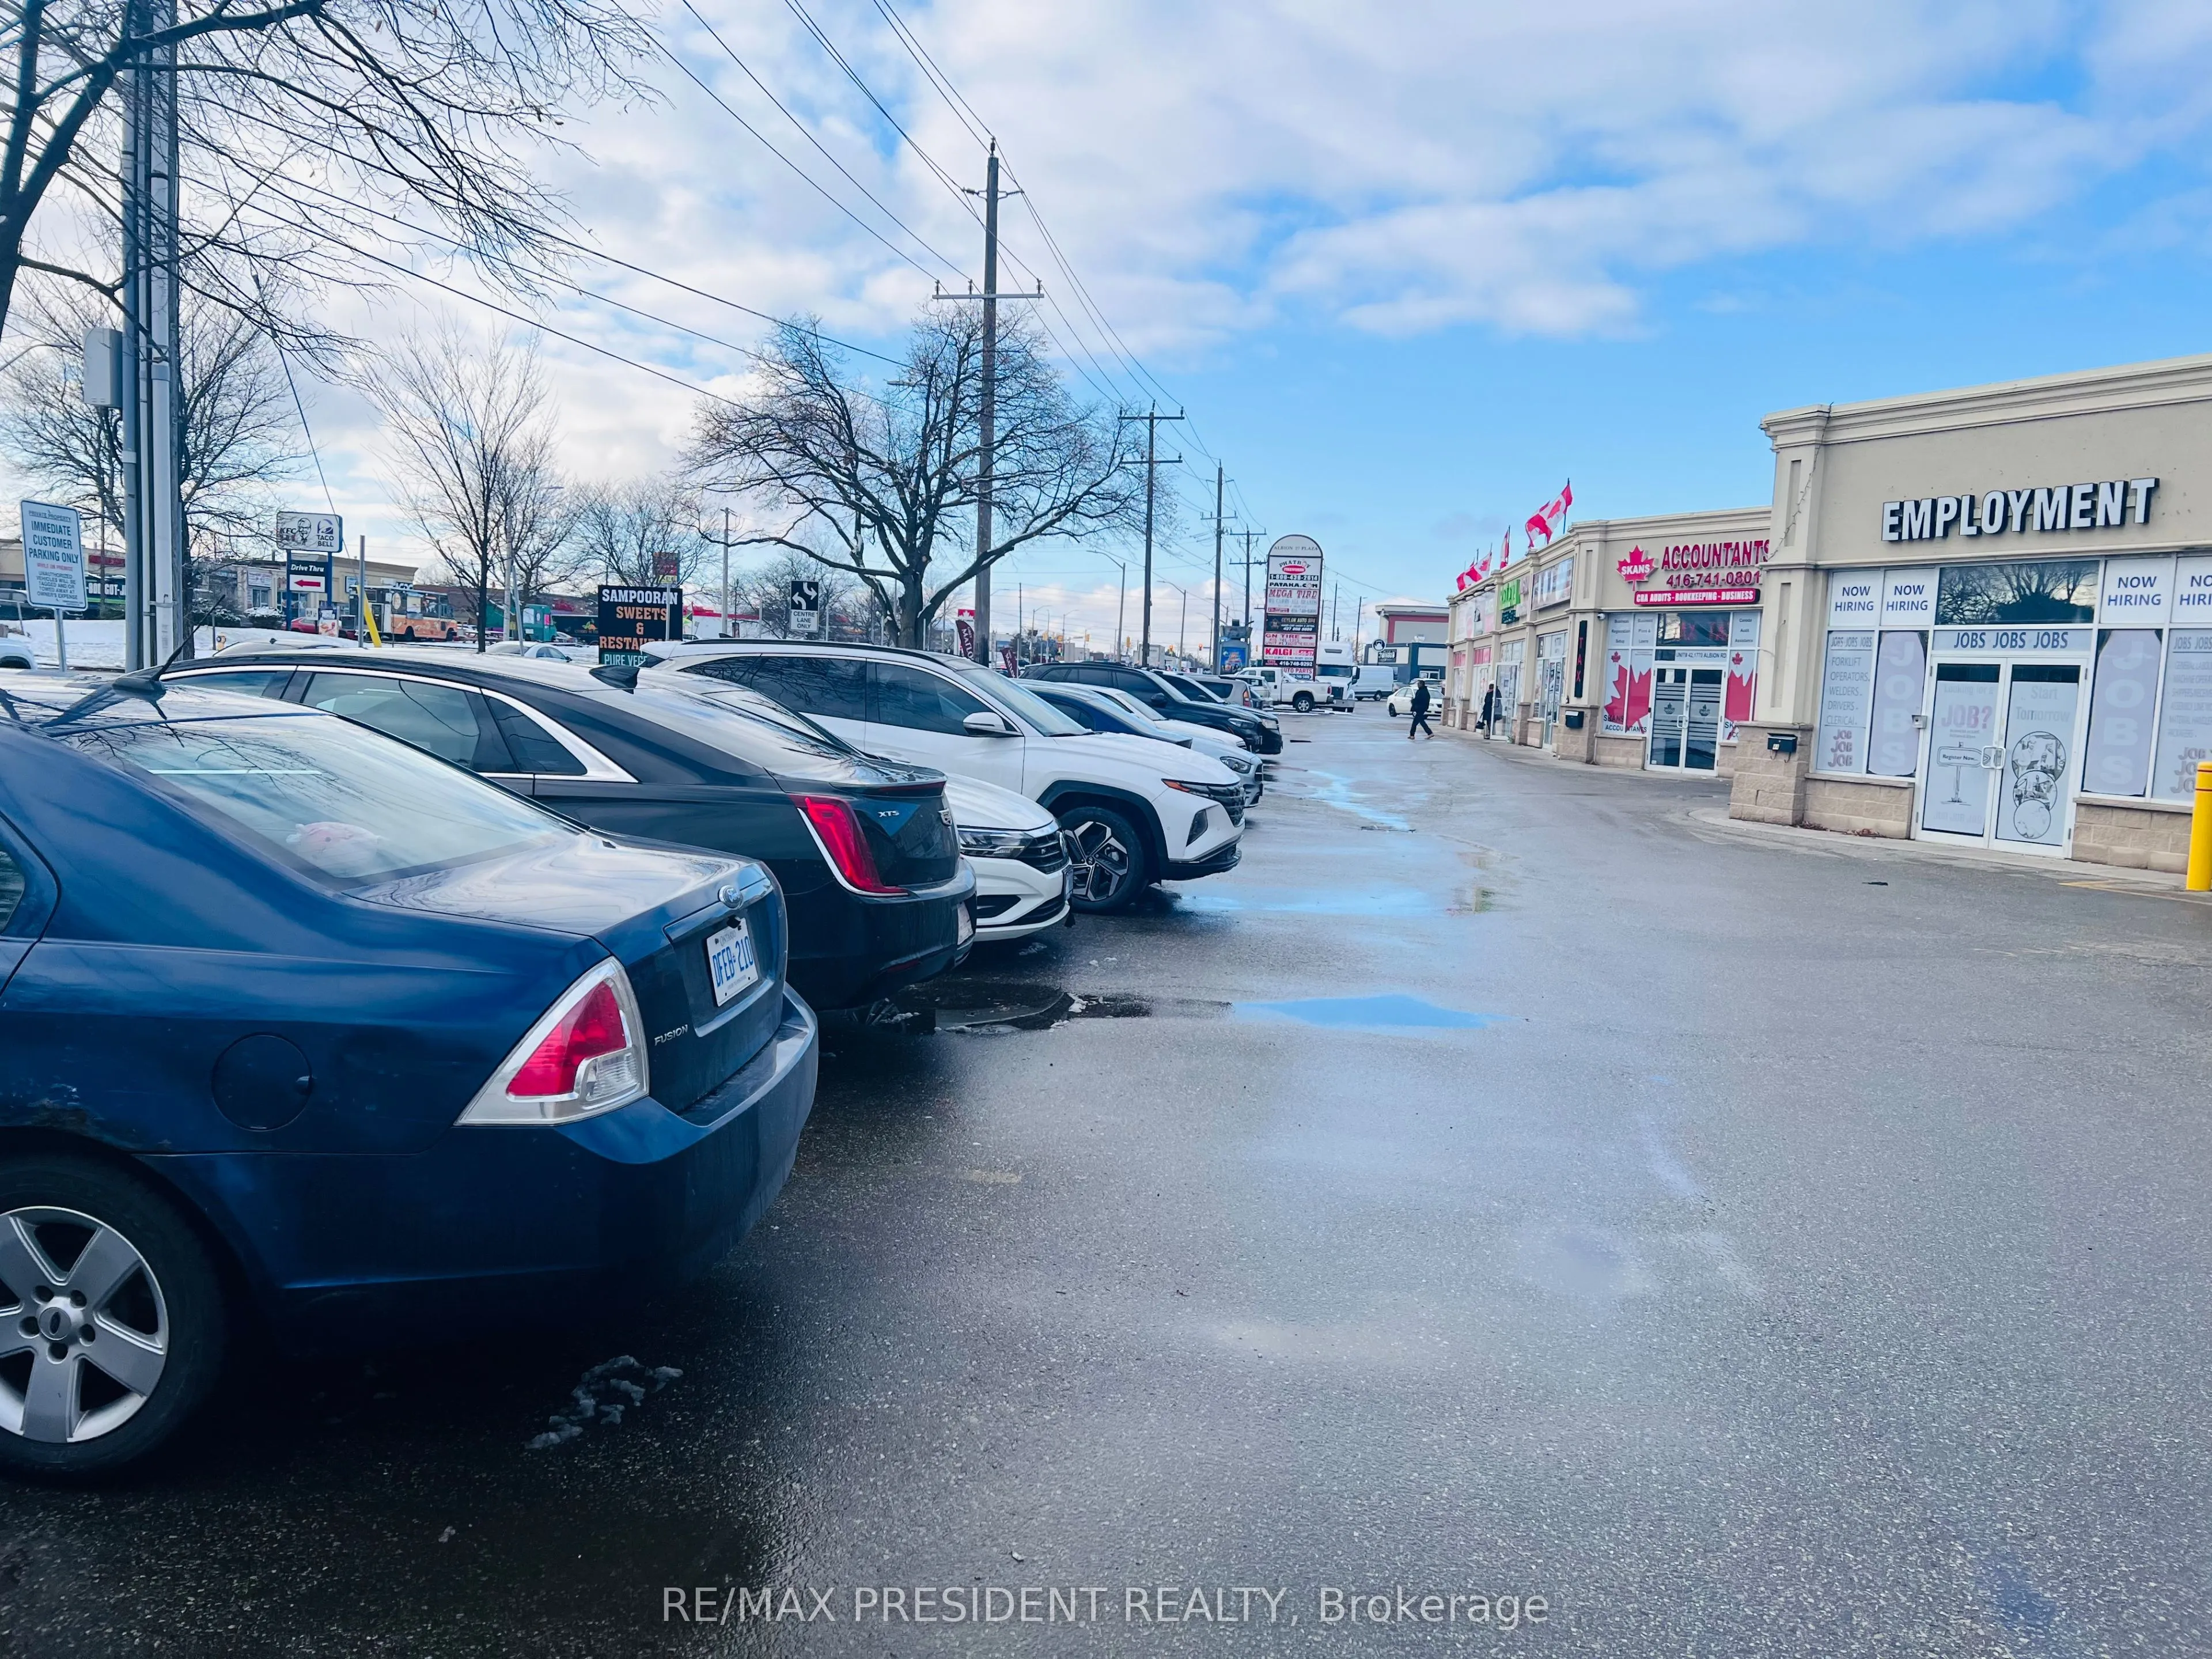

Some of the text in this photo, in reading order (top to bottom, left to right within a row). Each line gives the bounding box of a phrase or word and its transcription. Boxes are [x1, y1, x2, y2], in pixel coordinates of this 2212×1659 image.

[1881, 478, 2160, 541] EMPLOYMENT
[31, 521, 71, 536] IMMEDIATE
[33, 535, 73, 550] CUSTOMER
[29, 548, 79, 564] PARKING ONLY
[1661, 539, 1770, 570] ACCOUNTANTS
[1621, 564, 1650, 575] SKANS
[1666, 570, 1761, 586] 416-741-0801
[2118, 576, 2157, 588] NOW
[602, 589, 678, 605] SAMPOORAN
[1269, 589, 1317, 599] MEGA TIRE
[1675, 591, 1717, 602] BOOKKEEPING
[1721, 590, 1753, 601] BUSINESS
[1842, 586, 1871, 596] NOW
[1894, 585, 1925, 595] NOW
[1835, 601, 1874, 611] HIRING
[1886, 600, 1928, 611] HIRING
[2108, 594, 2161, 606] HIRING
[616, 606, 668, 620] SWEETS
[636, 622, 644, 635] &
[1954, 631, 2069, 649] JOBS JOBS JOBS
[2173, 637, 2191, 650] JOBS
[604, 654, 626, 665] PURE
[1575, 637, 1584, 682] TAX
[1831, 657, 1862, 666] FORKLIFT
[2031, 686, 2058, 700] Start
[1604, 714, 1624, 723] SKANS
[1941, 704, 1993, 729] JOB?
[2016, 706, 2071, 722] Tomorrow
[2174, 761, 2198, 775] JO
[654, 1024, 688, 1046] FUSION
